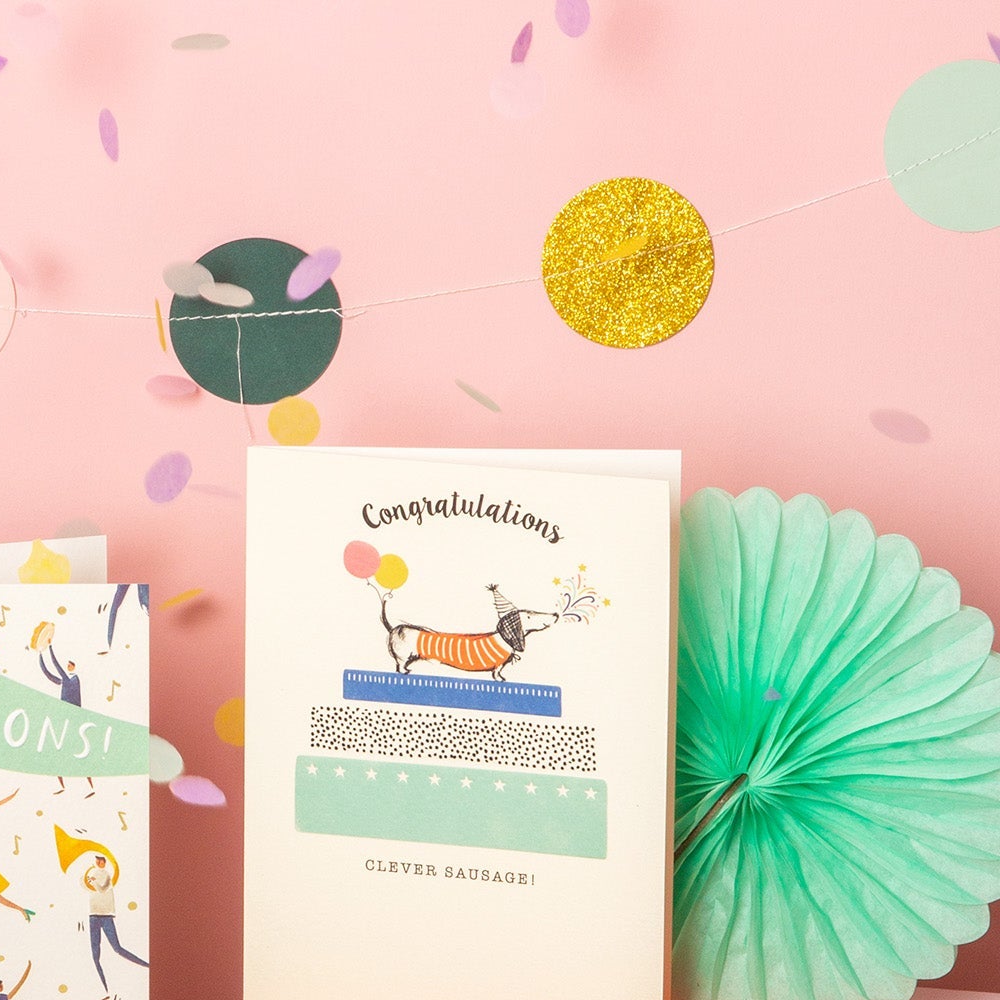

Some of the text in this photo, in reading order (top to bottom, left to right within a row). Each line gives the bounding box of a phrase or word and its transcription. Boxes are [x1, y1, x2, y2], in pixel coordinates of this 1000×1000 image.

[362, 491, 565, 544] Congratulations
[365, 859, 536, 886] CLEVER SAUSAGE!
